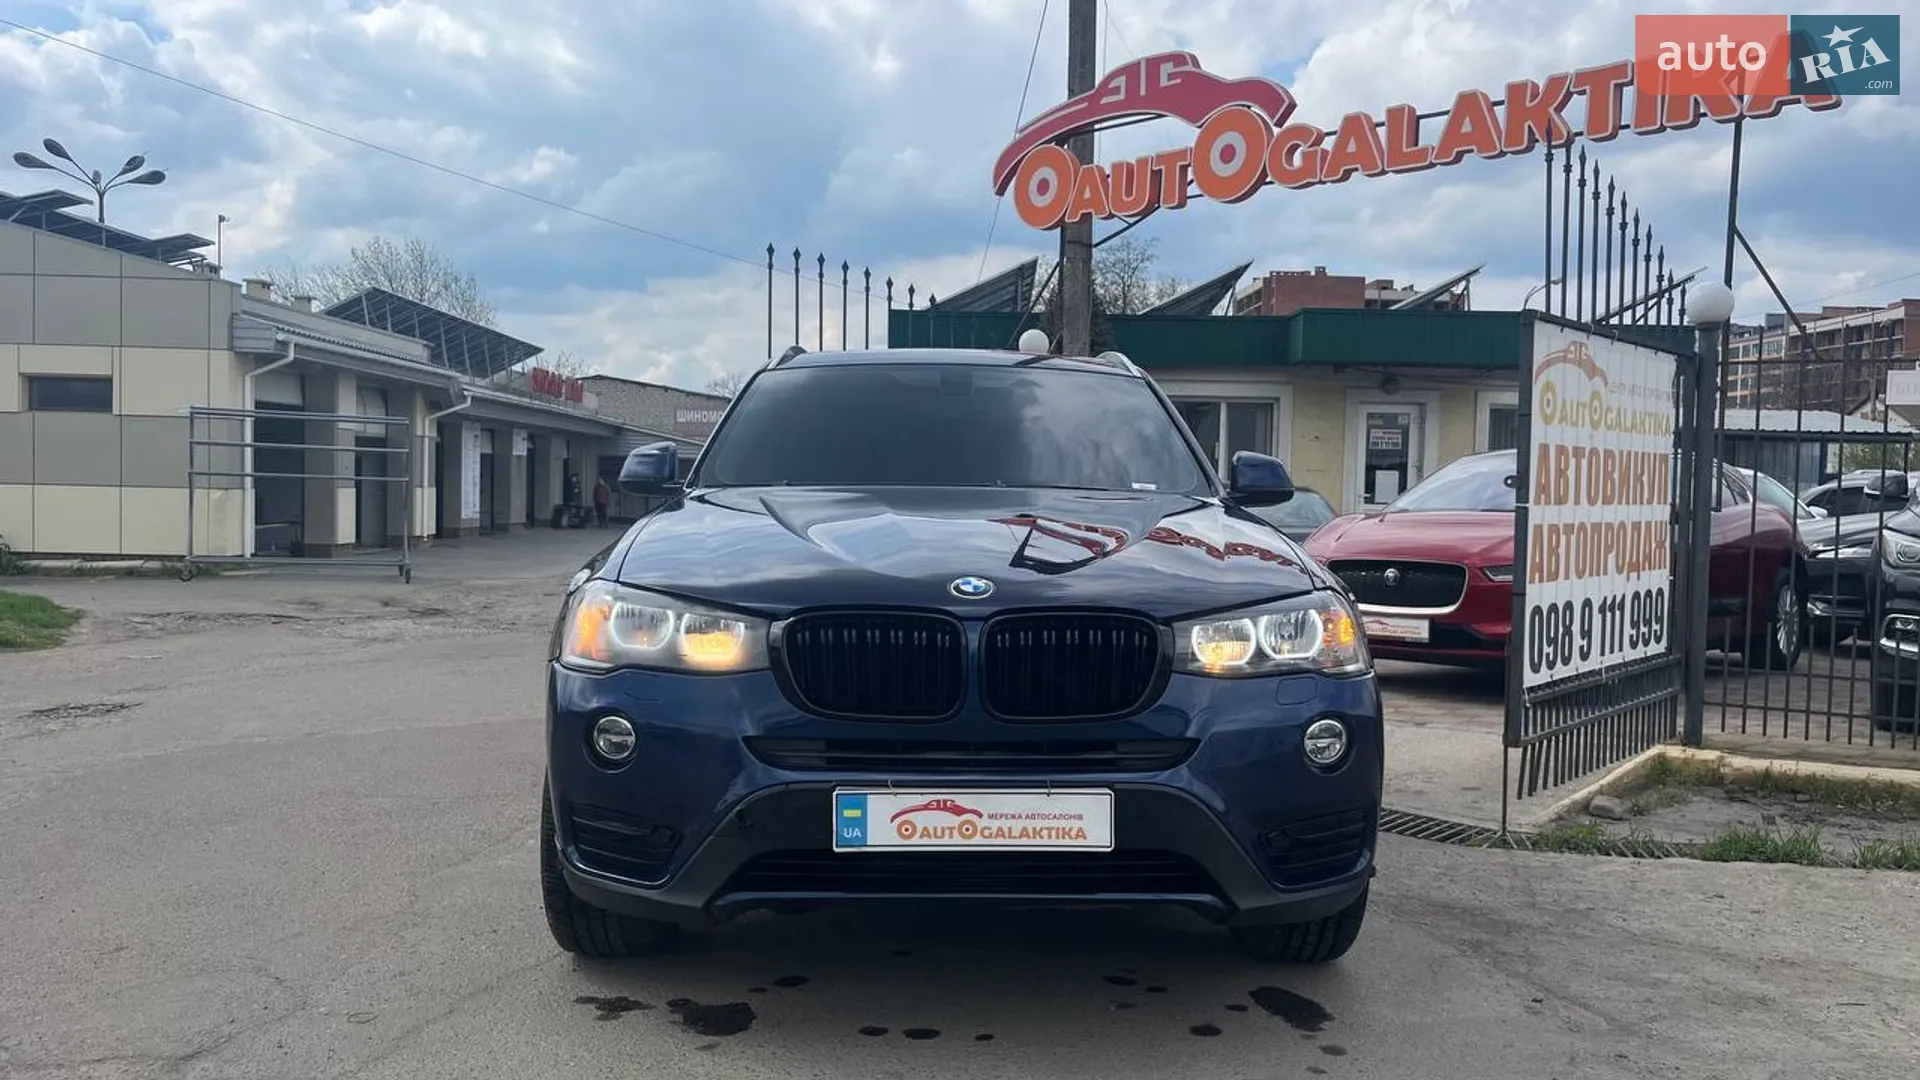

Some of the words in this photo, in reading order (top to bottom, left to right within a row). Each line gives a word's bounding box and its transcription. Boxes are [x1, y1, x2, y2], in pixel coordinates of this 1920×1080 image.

[1534, 443, 1669, 506] АВТОВИКУП
[1529, 521, 1668, 583] АВТОПРОДАЖ
[1528, 598, 1574, 675] 098
[1579, 597, 1593, 663] 9
[1598, 592, 1626, 657] 111
[1629, 587, 1665, 650] 999
[843, 829, 862, 839] UA
[987, 812, 1023, 821] МЕРЕЖА
[1025, 812, 1084, 821] АВТОСАЛОНІВ
